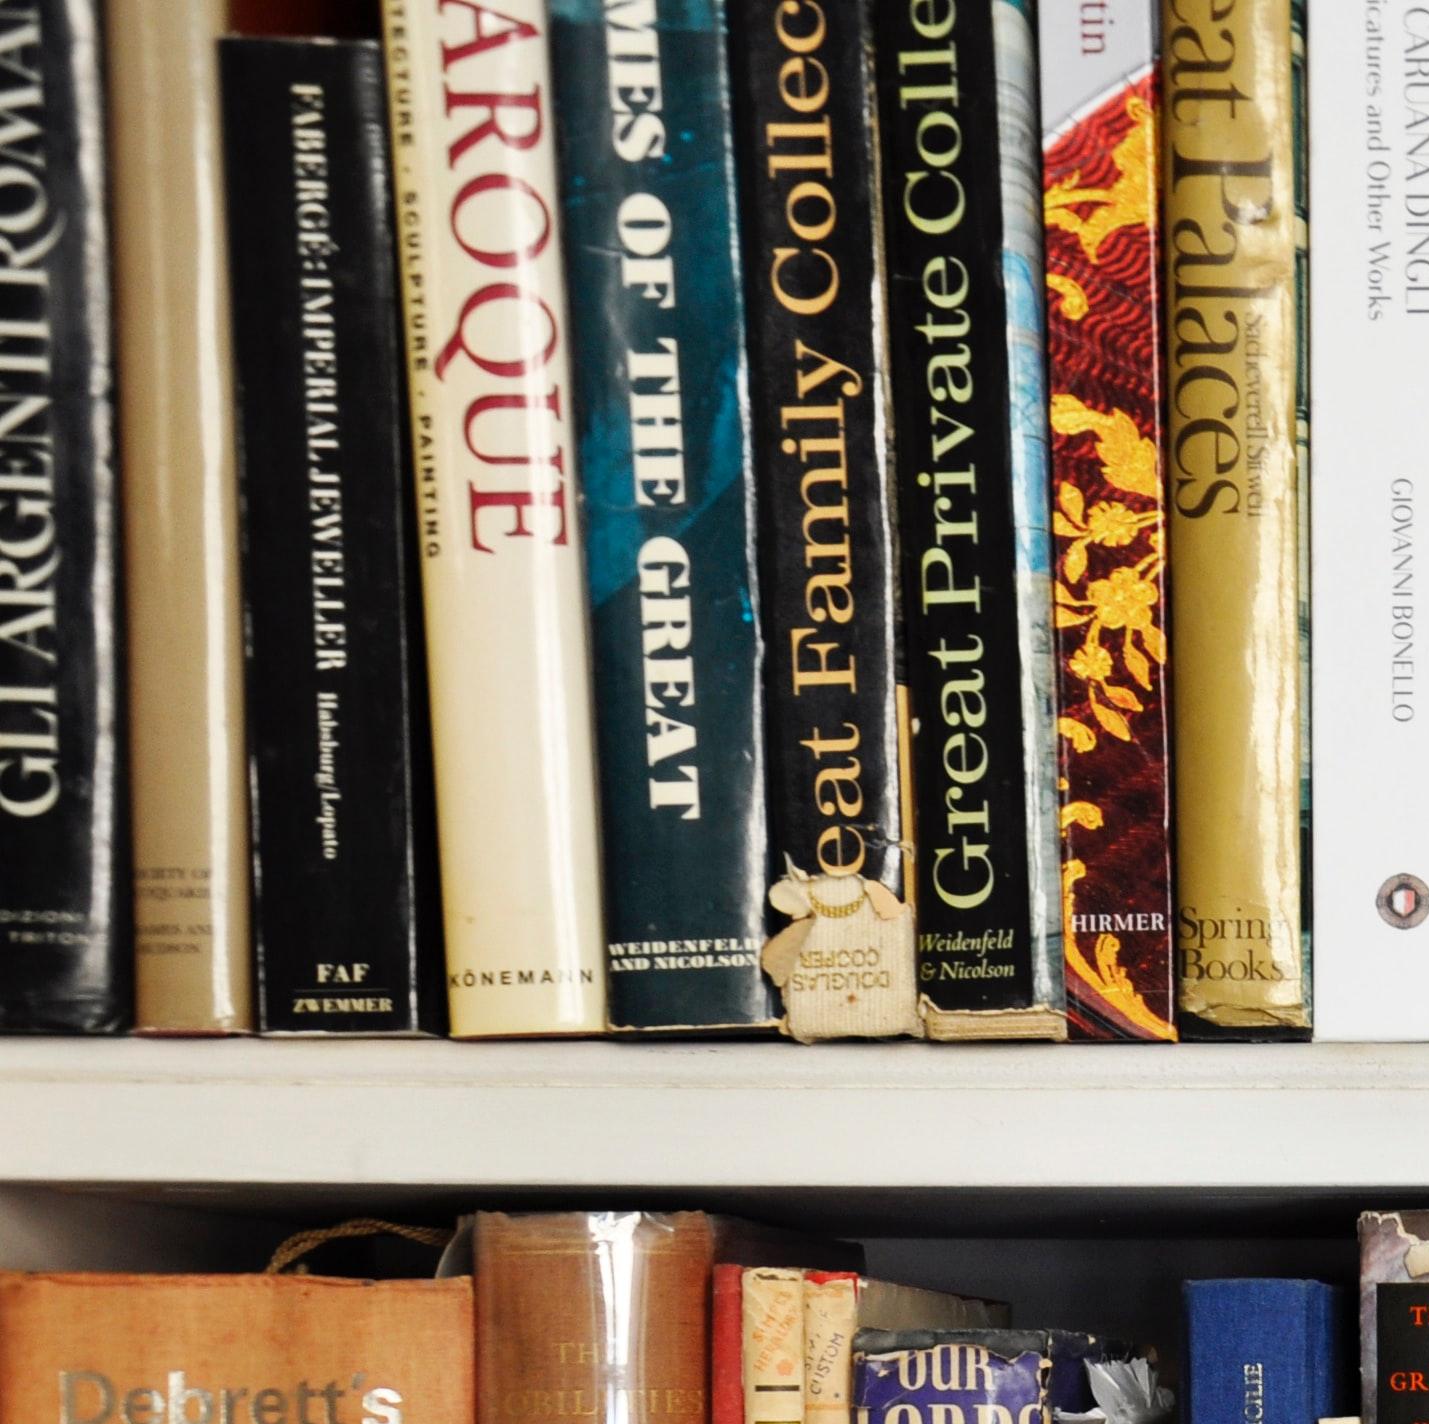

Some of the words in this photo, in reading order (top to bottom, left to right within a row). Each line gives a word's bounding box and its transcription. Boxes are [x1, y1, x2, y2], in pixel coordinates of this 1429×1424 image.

[616, 194, 676, 310] OF
[301, 277, 341, 460] IMPERIAL
[402, 190, 430, 372] SCULPTURE
[416, 414, 442, 559] PAINTING
[1171, 156, 1273, 520] Palaces
[627, 338, 687, 507] THE
[914, 255, 982, 614] Private
[308, 469, 348, 670] JEWELLER
[779, 338, 862, 697] Family
[1391, 478, 1414, 597] GIOVANNI
[637, 537, 700, 820] GREAT
[1391, 605, 1415, 723] BONELLO
[921, 633, 995, 911] Great
[317, 963, 370, 984] FAF
[450, 966, 595, 987] KÖNEMANN
[918, 929, 1014, 958] Weidenfeld
[939, 957, 1016, 982] Nicolson
[1071, 912, 1167, 934] HIRMER
[1178, 907, 1284, 953] Spring
[1180, 949, 1286, 983] Books
[293, 997, 393, 1014] ZWEMMER
